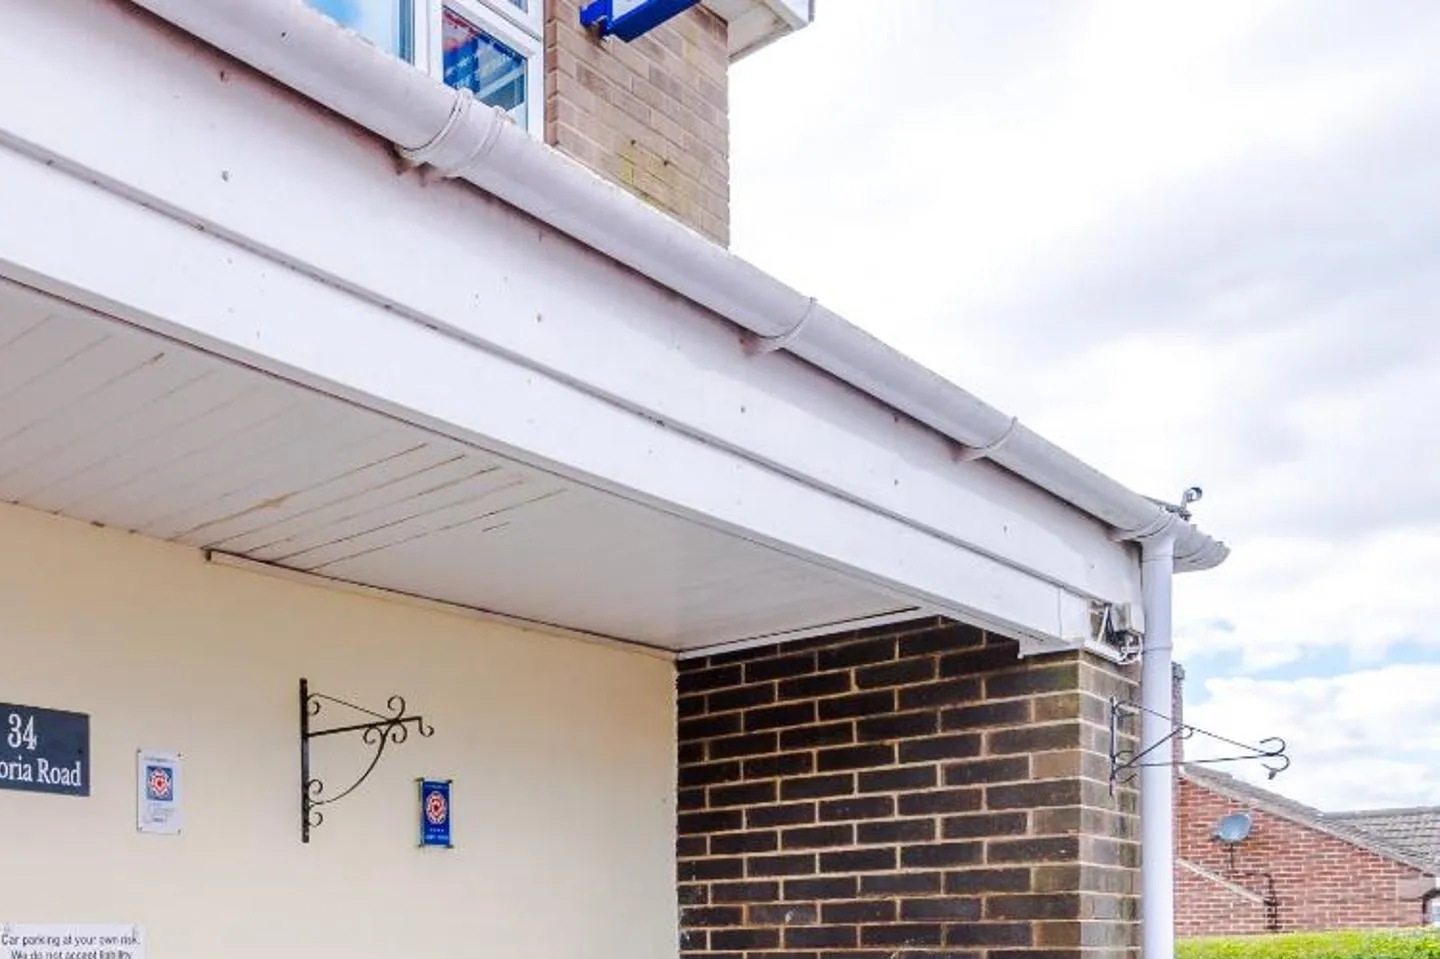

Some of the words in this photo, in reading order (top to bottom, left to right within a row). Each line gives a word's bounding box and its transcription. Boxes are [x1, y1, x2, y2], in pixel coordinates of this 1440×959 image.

[7, 713, 37, 750] 34
[37, 758, 81, 786] Road
[1, 934, 19, 945] Car
[23, 935, 60, 947] parking
[63, 935, 72, 945] at
[75, 936, 96, 947] your
[99, 936, 119, 945] own
